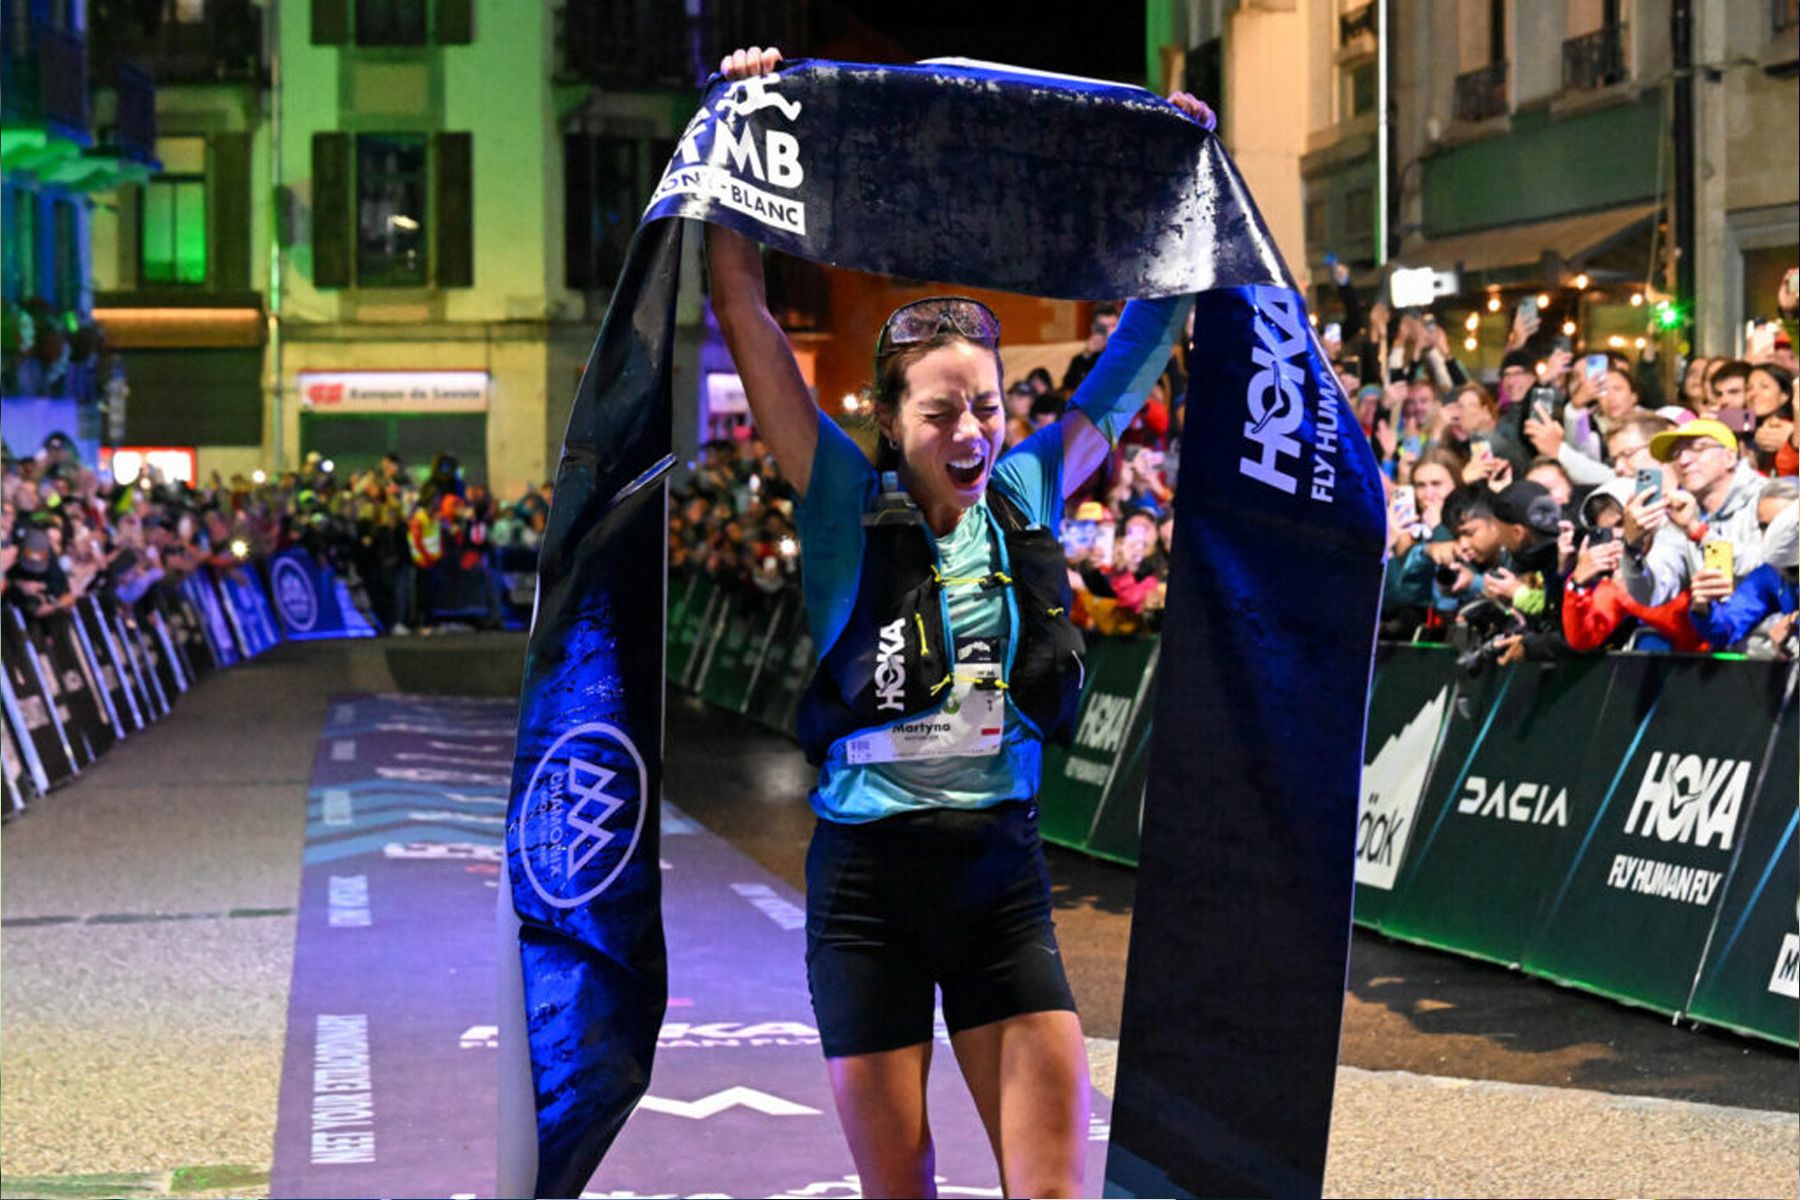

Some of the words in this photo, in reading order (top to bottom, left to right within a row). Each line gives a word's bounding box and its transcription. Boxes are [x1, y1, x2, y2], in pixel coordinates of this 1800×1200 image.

[672, 118, 804, 189] TMB
[1239, 284, 1308, 494] HOKA
[1315, 370, 1340, 453] HUMA
[1311, 454, 1336, 503] FLY
[874, 617, 906, 712] HOKA
[892, 721, 951, 736] Martyna
[551, 771, 565, 876] CHAMONIX
[1357, 792, 1404, 867] äak
[1457, 775, 1568, 828] DACIA
[1624, 751, 1752, 850] HOKA
[1607, 854, 1639, 889] FLY
[1631, 858, 1695, 903] HUMAN
[1687, 869, 1723, 906] FLY
[310, 1092, 375, 1131] YOUR
[310, 1131, 376, 1164] MEET
